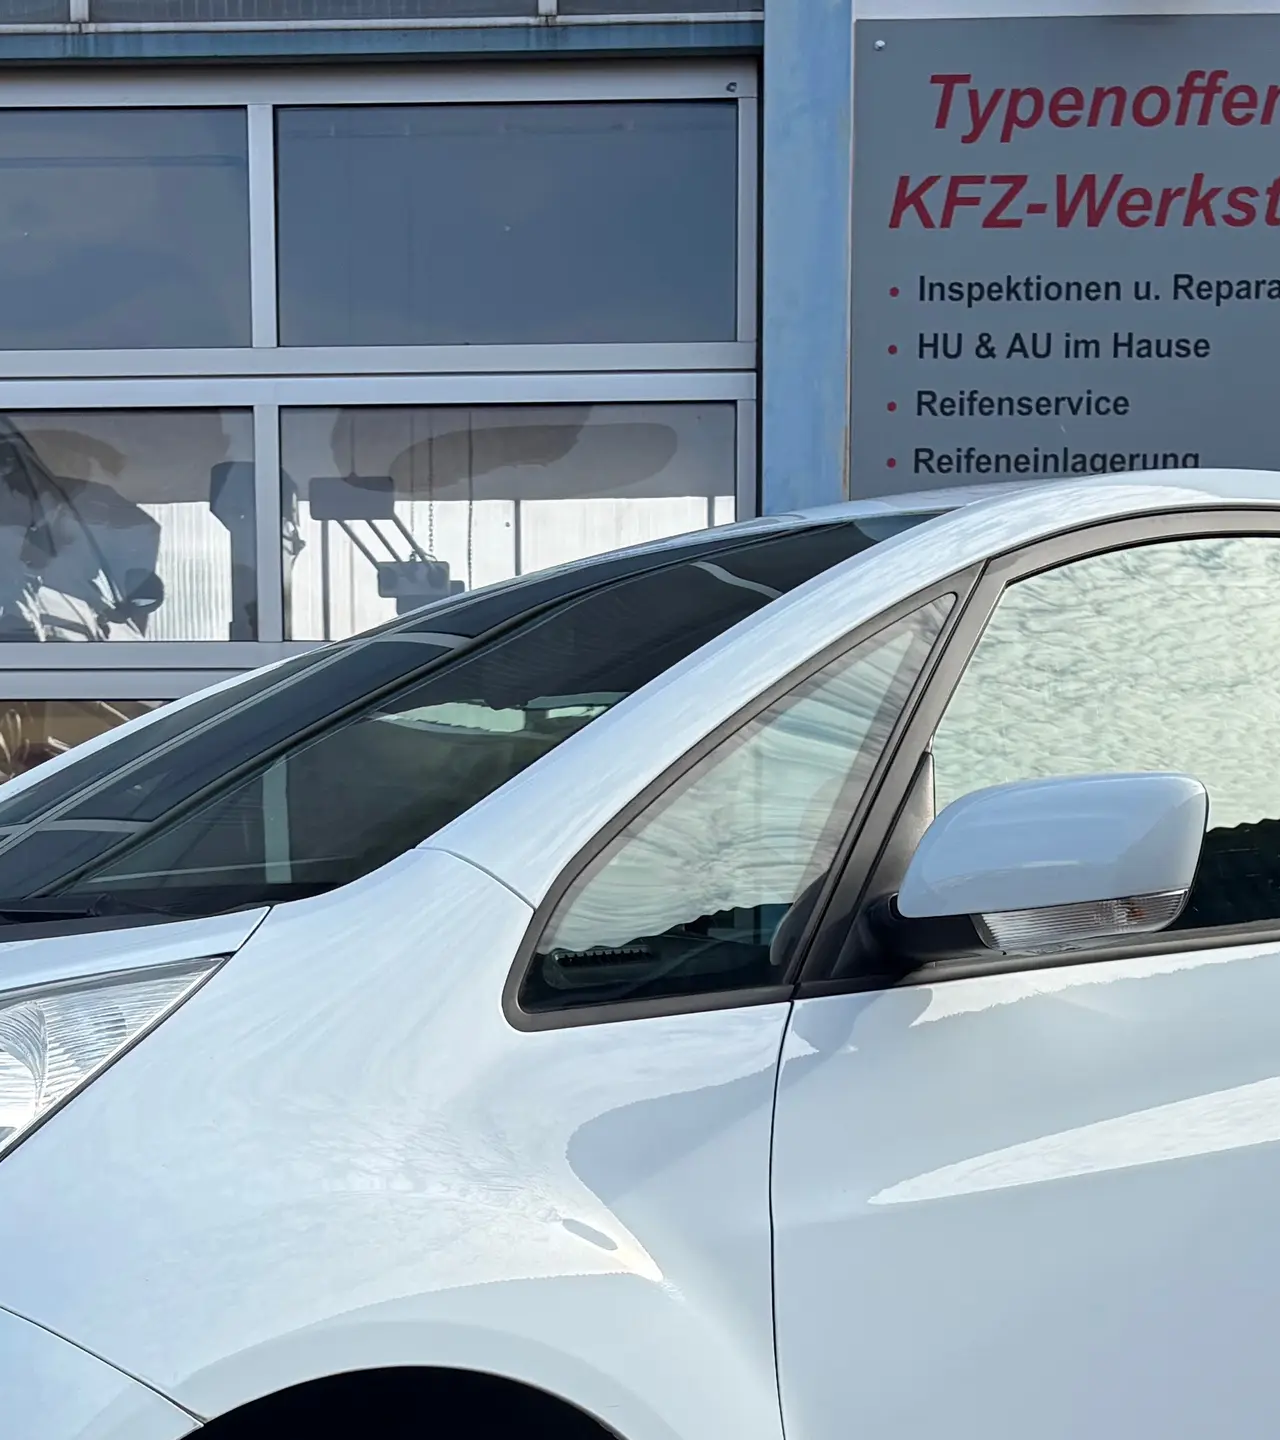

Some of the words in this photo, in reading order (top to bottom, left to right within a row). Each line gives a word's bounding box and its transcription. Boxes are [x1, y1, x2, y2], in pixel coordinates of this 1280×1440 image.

[918, 275, 1122, 308] Inspektionen
[1133, 280, 1161, 302] u.
[918, 333, 963, 360] HU
[975, 332, 997, 360] &
[1006, 333, 1053, 359] AU
[1064, 332, 1101, 358] im
[1112, 332, 1211, 359] Hause
[916, 389, 1130, 417] Reifenservice
